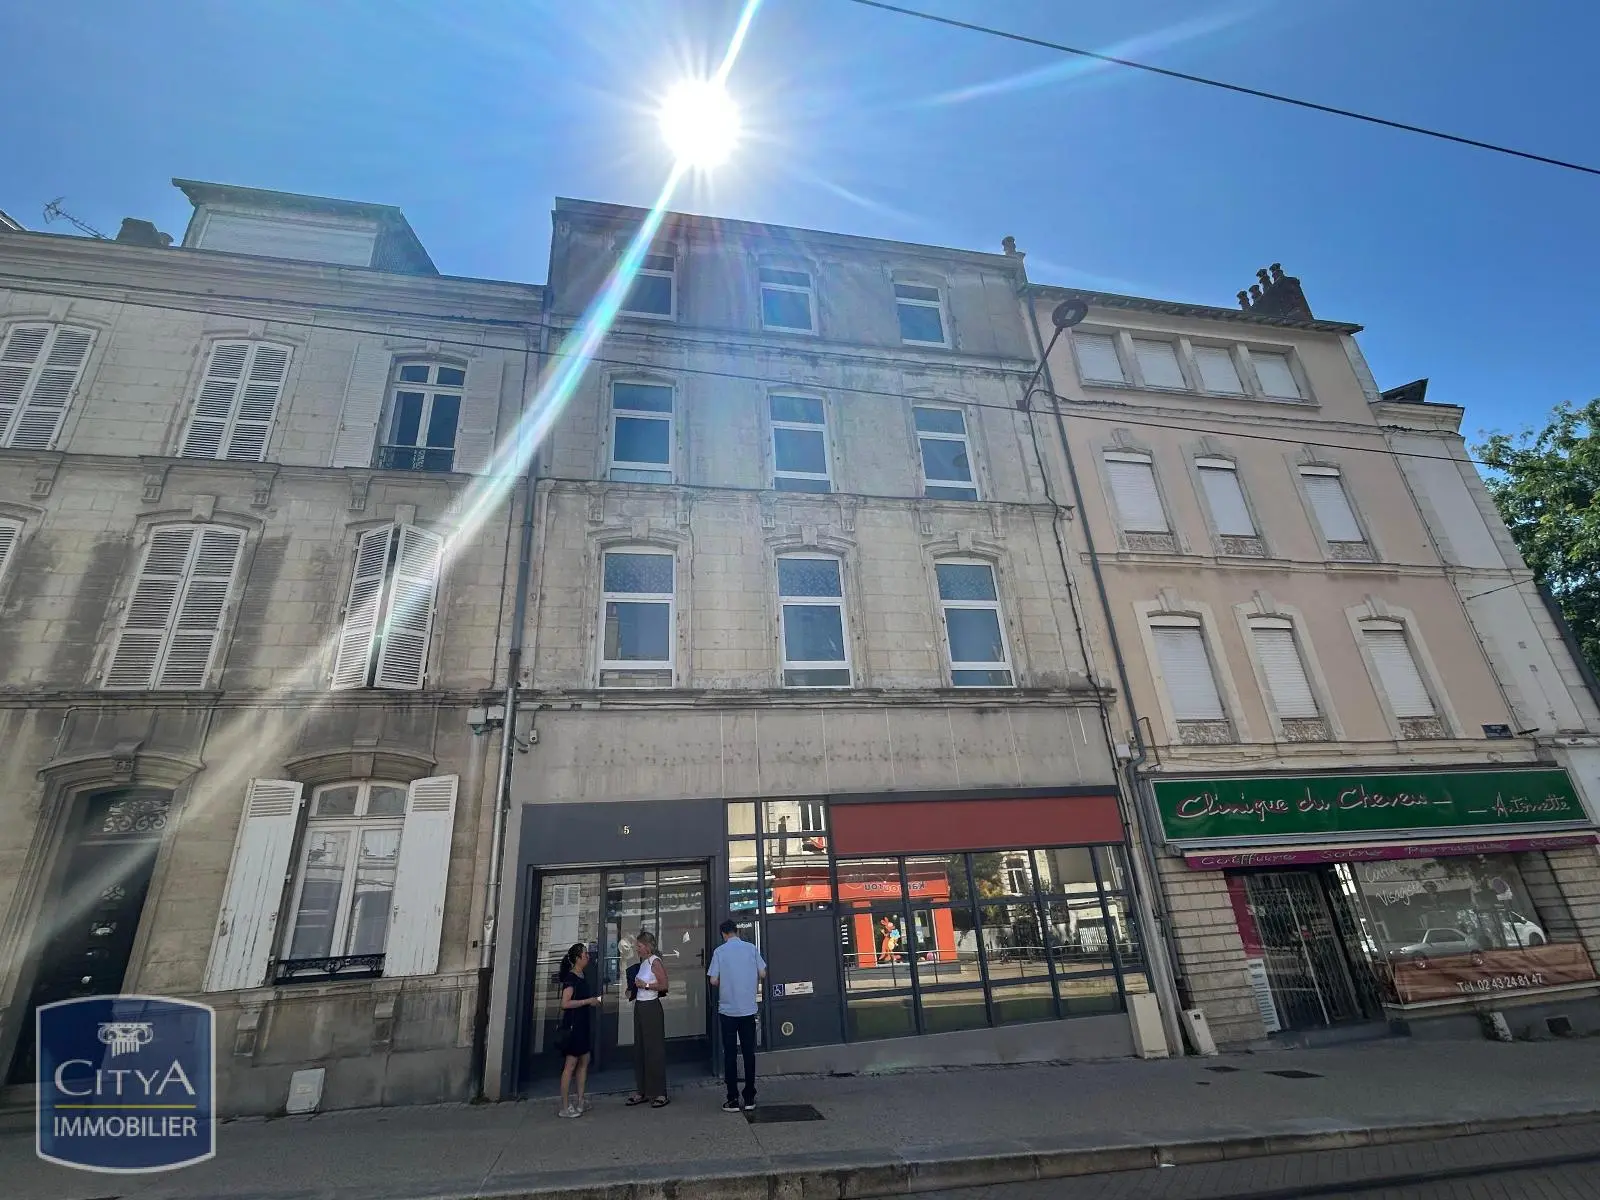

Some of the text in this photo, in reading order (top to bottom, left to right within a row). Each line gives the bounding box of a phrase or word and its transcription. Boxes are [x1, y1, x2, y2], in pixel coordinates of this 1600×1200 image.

[1178, 783, 1428, 822] Clinique du Cheveu
[1477, 979, 1490, 991] 02
[1492, 977, 1504, 990] 43
[1505, 975, 1518, 988] 24
[1532, 973, 1543, 985] 47
